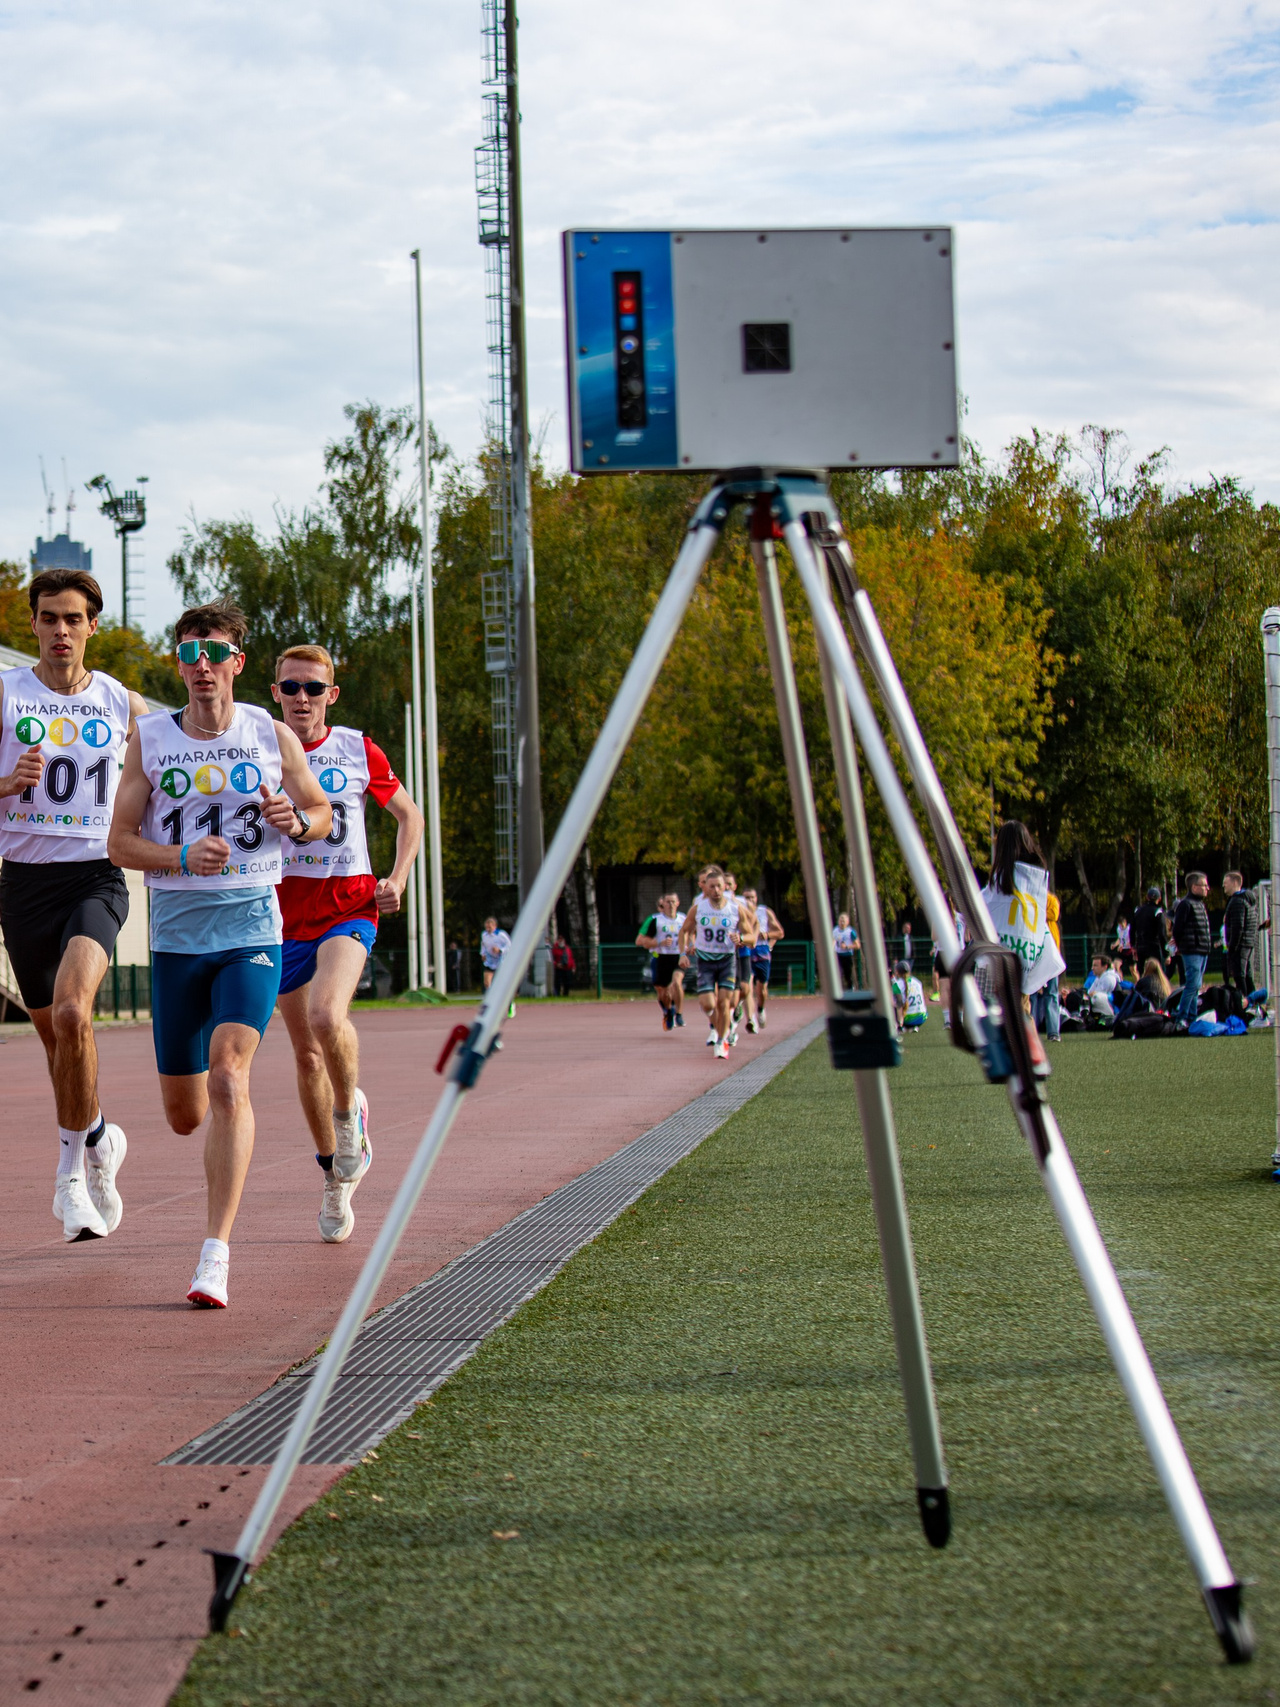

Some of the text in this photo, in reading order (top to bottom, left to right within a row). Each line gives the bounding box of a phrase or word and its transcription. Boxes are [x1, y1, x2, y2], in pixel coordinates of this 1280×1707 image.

[15, 704, 111, 718] VMARAFONE
[157, 747, 260, 767] VMARAFONE
[308, 755, 347, 767] FONE
[6, 812, 112, 827] VMARAFONE.CL
[161, 801, 265, 854] 113
[282, 854, 356, 867] RAFONE.CLUB
[163, 860, 279, 878] VMAONE.CLUB
[704, 927, 726, 943] 98
[908, 993, 923, 1007] 23
